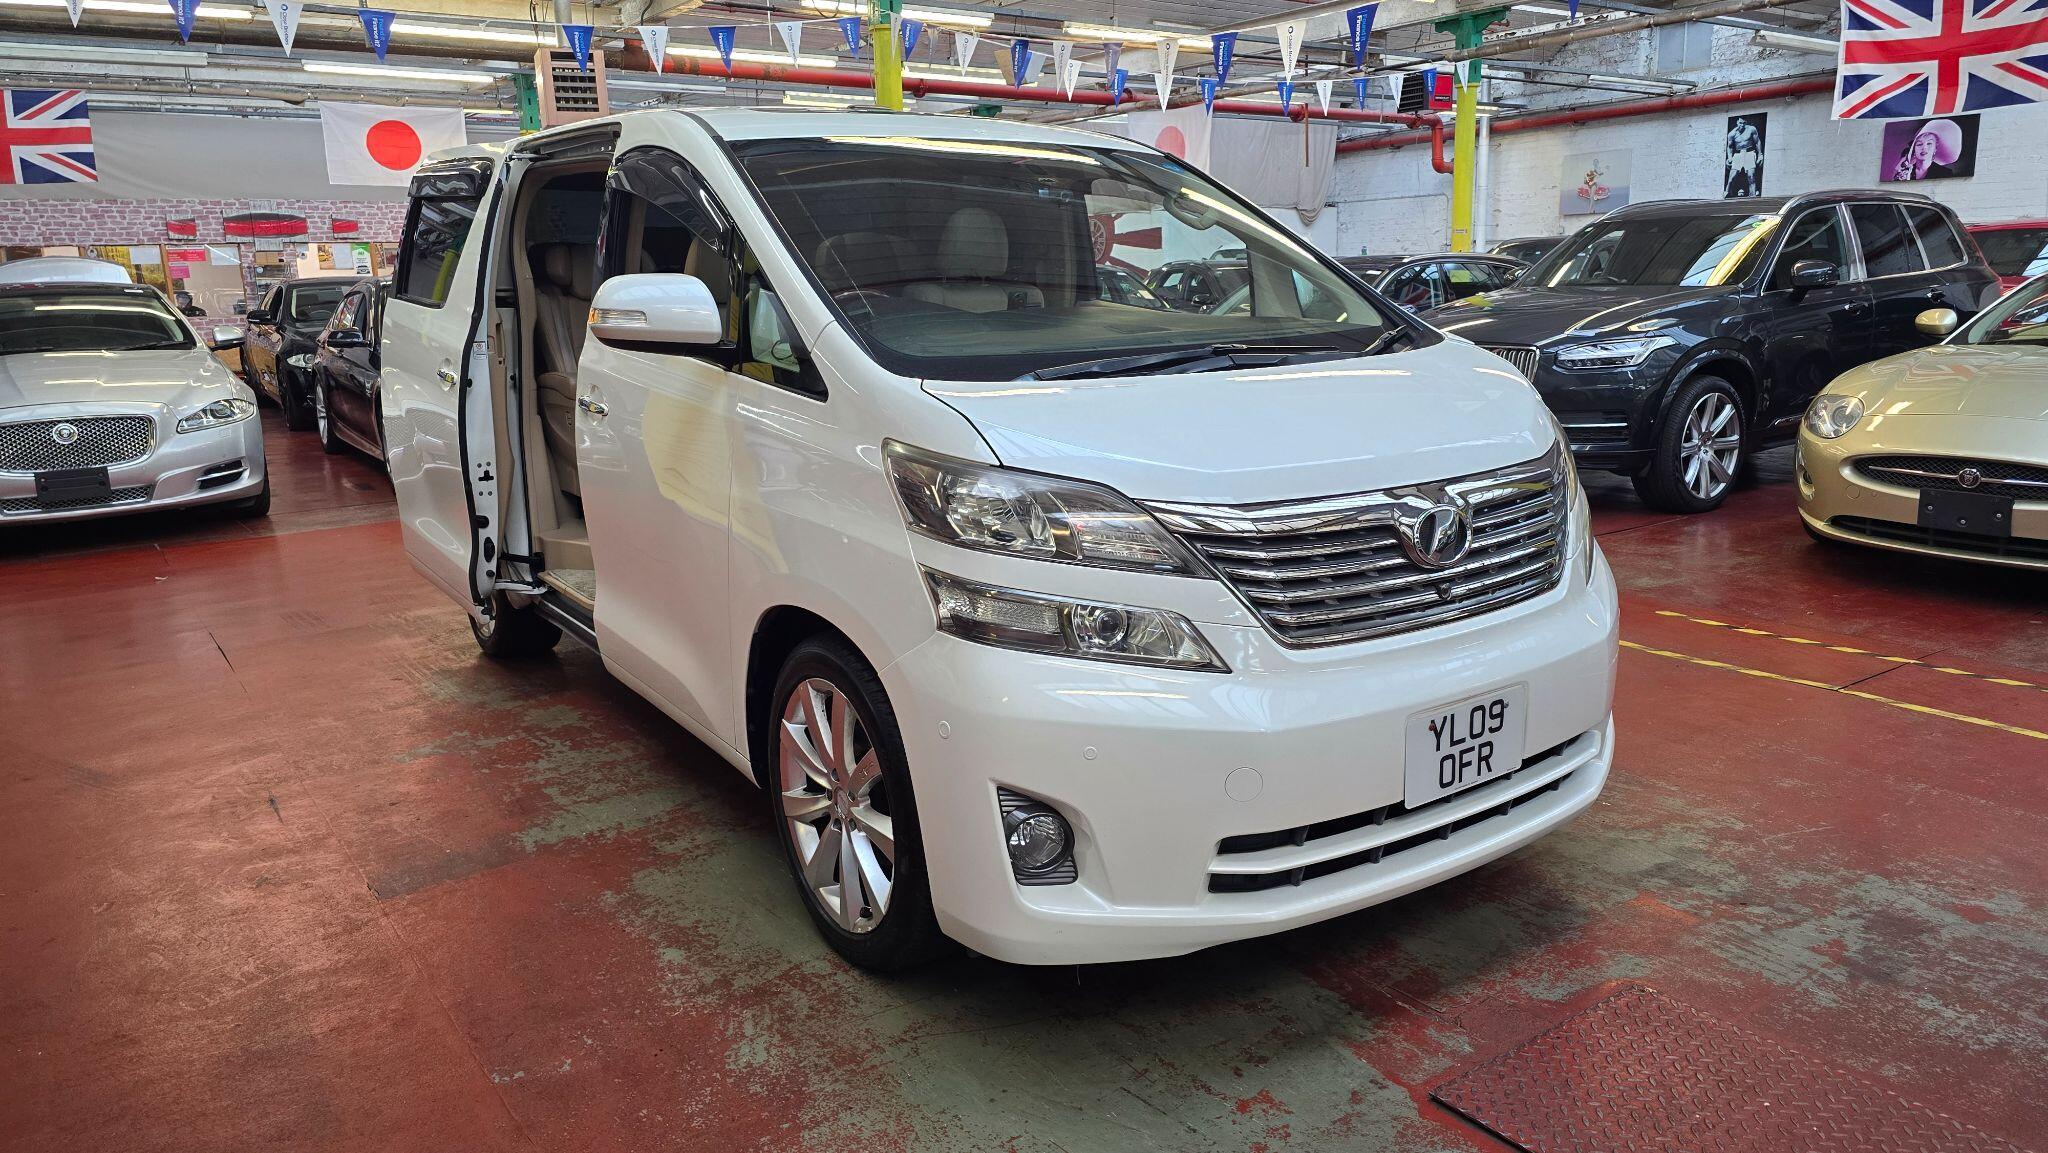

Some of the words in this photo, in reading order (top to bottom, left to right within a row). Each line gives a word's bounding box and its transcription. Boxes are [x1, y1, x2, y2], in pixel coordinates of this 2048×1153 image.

[372, 18, 380, 39] Finance
[573, 32, 581, 52] Finance
[1431, 699, 1505, 752] YL09
[1439, 740, 1494, 789] OFR
